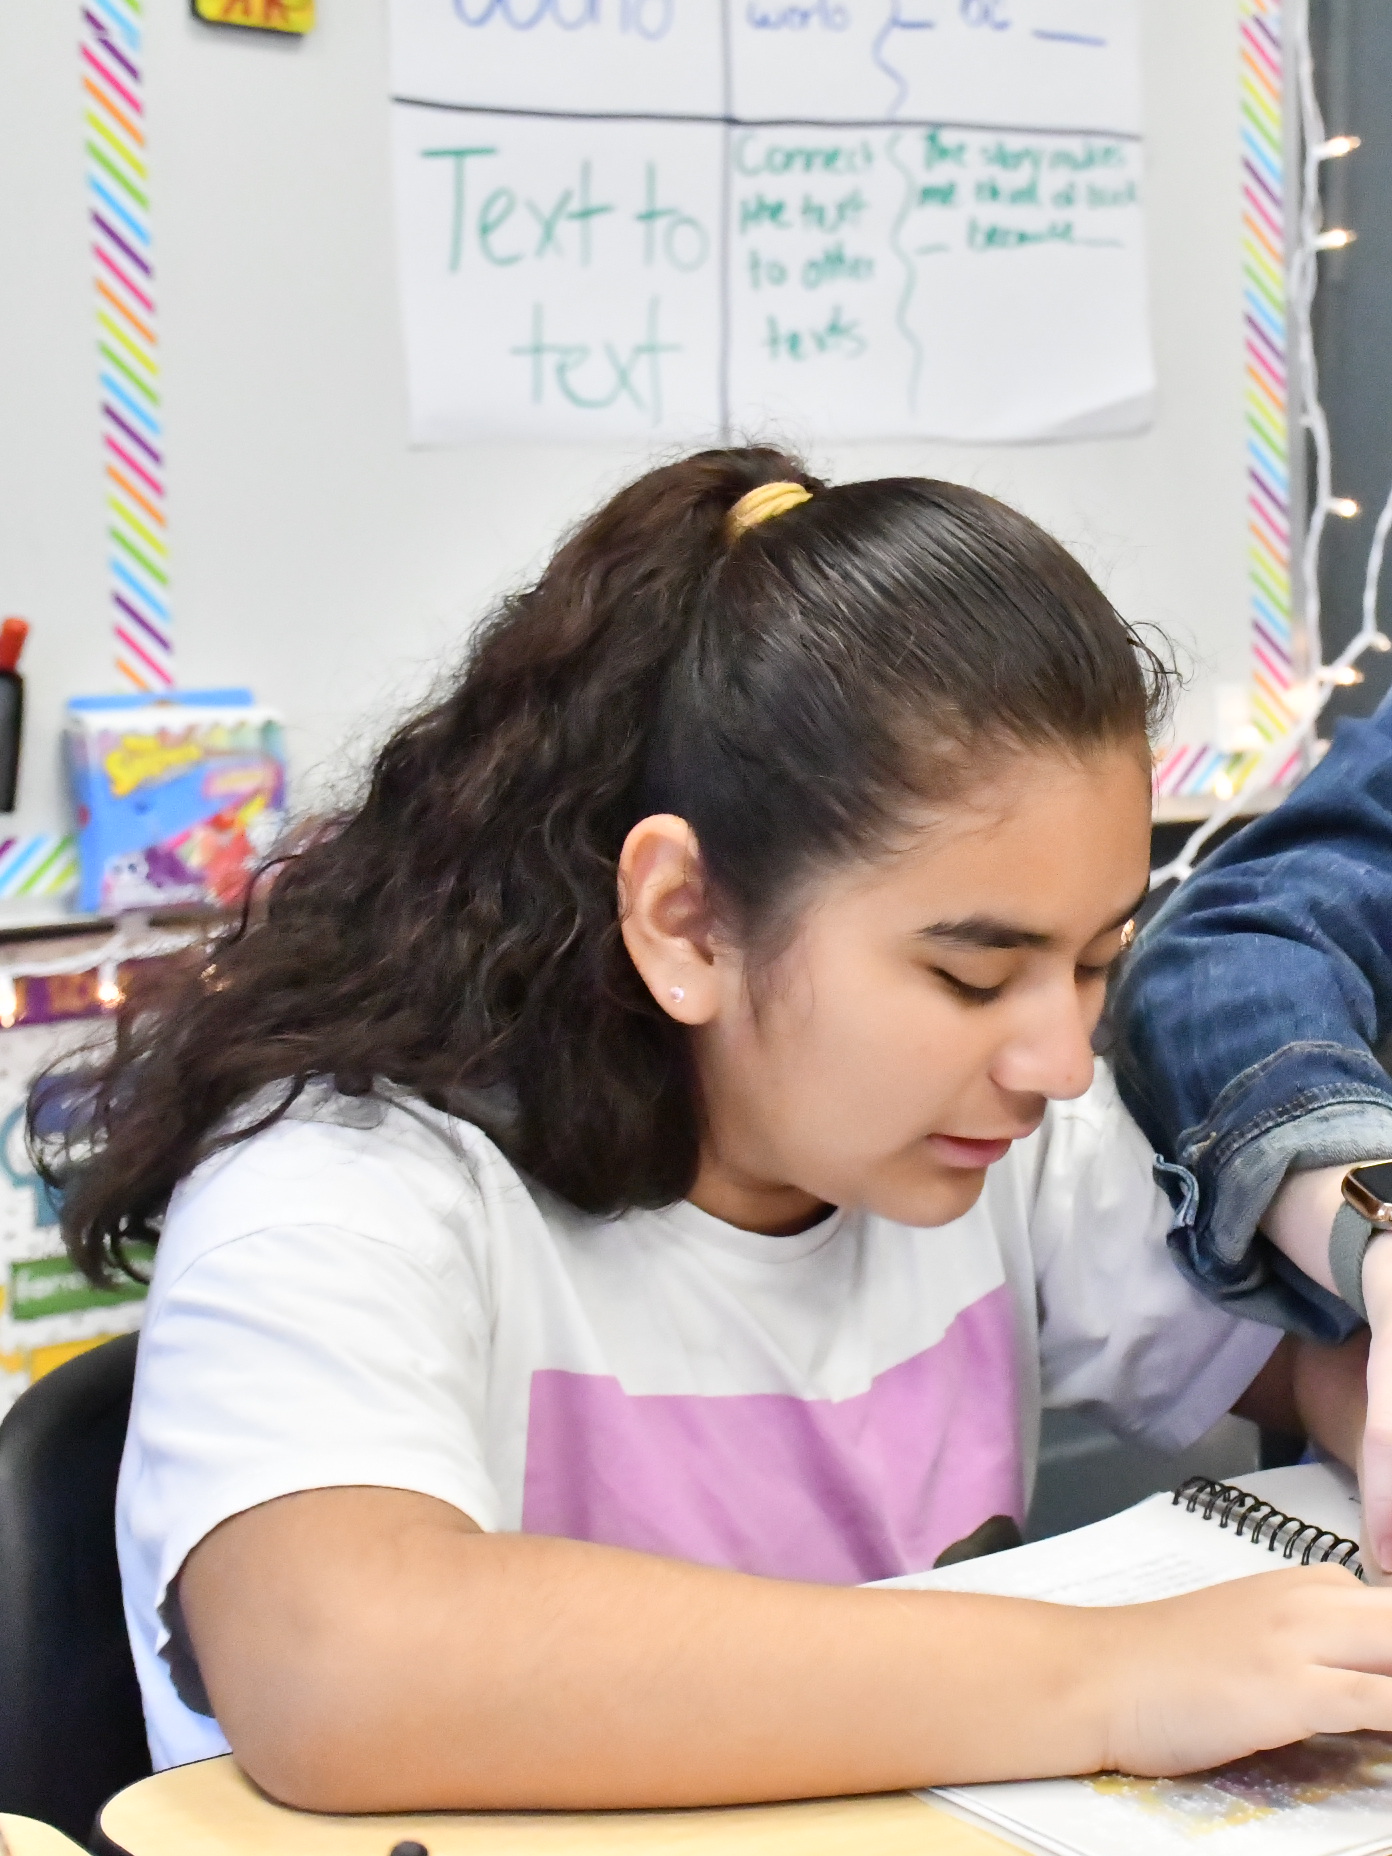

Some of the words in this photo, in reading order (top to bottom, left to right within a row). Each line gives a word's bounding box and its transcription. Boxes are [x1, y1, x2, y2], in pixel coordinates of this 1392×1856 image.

[420, 145, 618, 275] Text
[635, 158, 712, 272] to
[748, 248, 790, 292] to
[508, 298, 686, 426] text
[762, 303, 868, 362] texts
